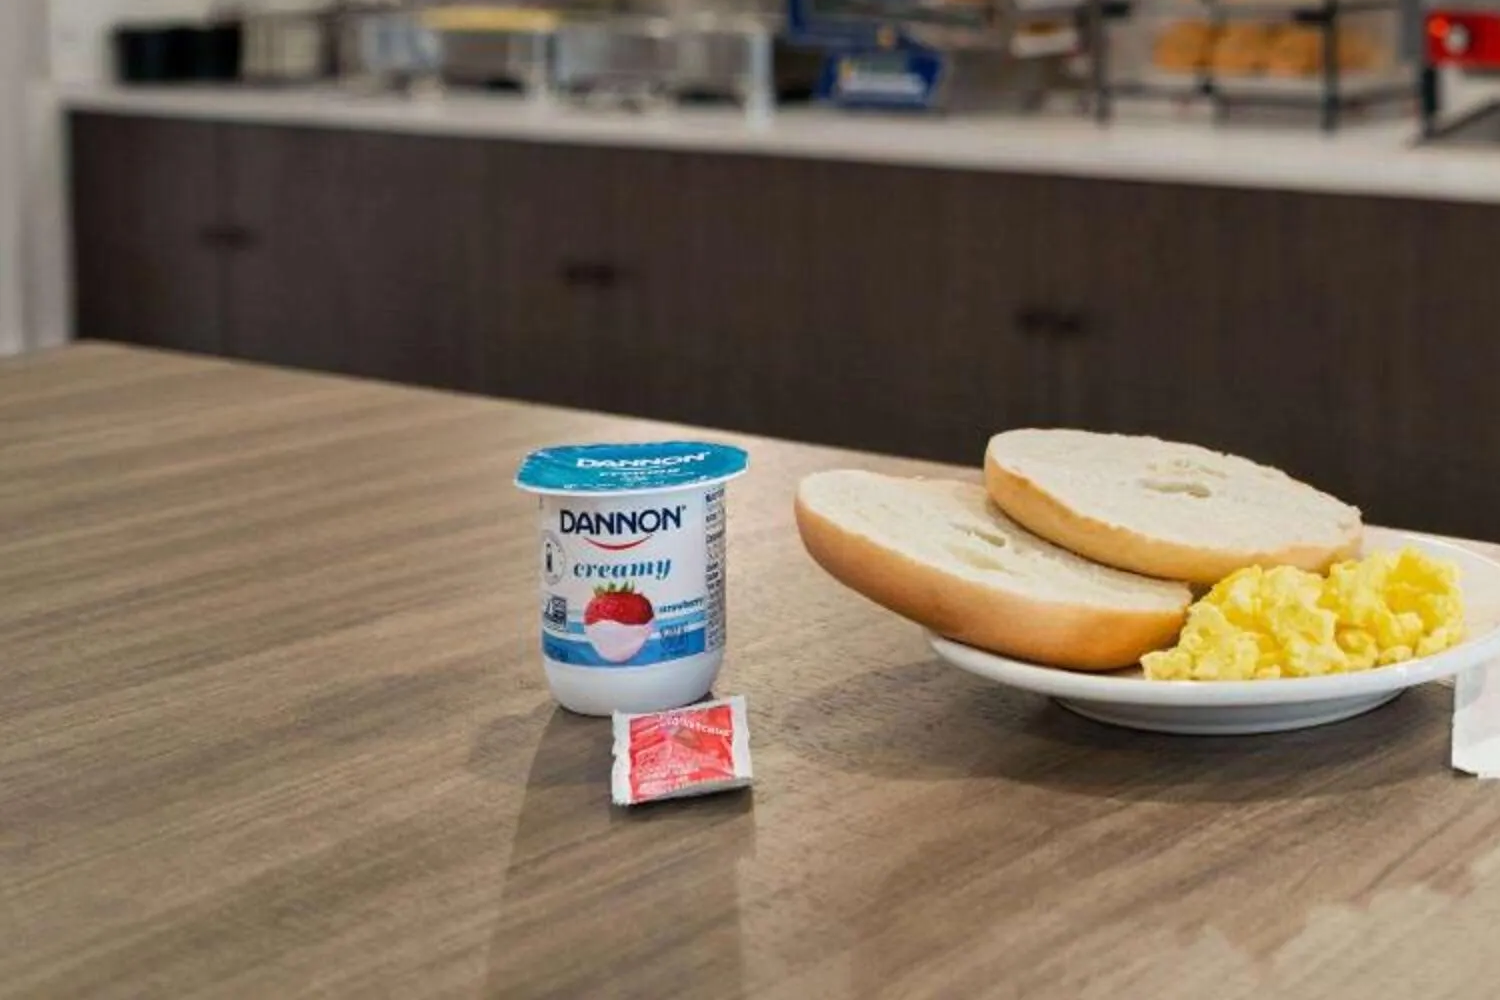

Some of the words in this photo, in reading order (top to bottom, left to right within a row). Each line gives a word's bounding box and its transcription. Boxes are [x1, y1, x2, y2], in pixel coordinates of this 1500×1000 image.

[576, 452, 706, 468] DANNON
[560, 505, 681, 535] DANNON
[574, 559, 671, 580] creamy
